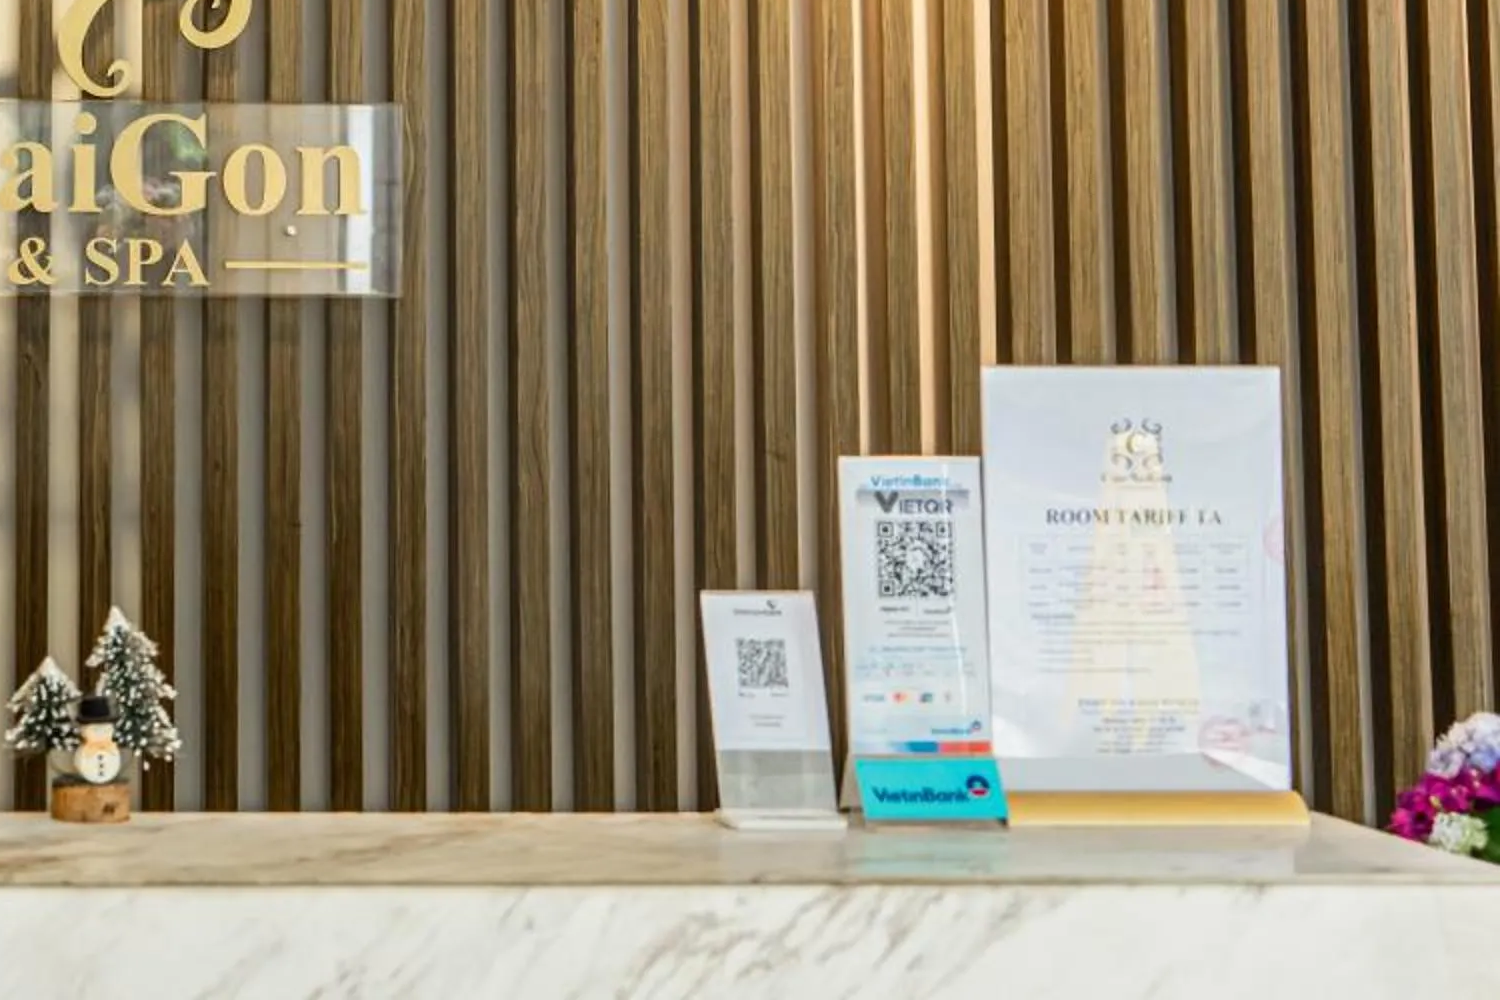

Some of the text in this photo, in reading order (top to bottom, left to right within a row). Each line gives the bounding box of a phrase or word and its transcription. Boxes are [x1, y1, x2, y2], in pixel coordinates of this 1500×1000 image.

[8, 238, 58, 285] &
[84, 239, 211, 287] SPA
[1045, 508, 1110, 525] ROOM
[1117, 508, 1189, 526] TARIFF
[871, 785, 971, 804] VietinBank
